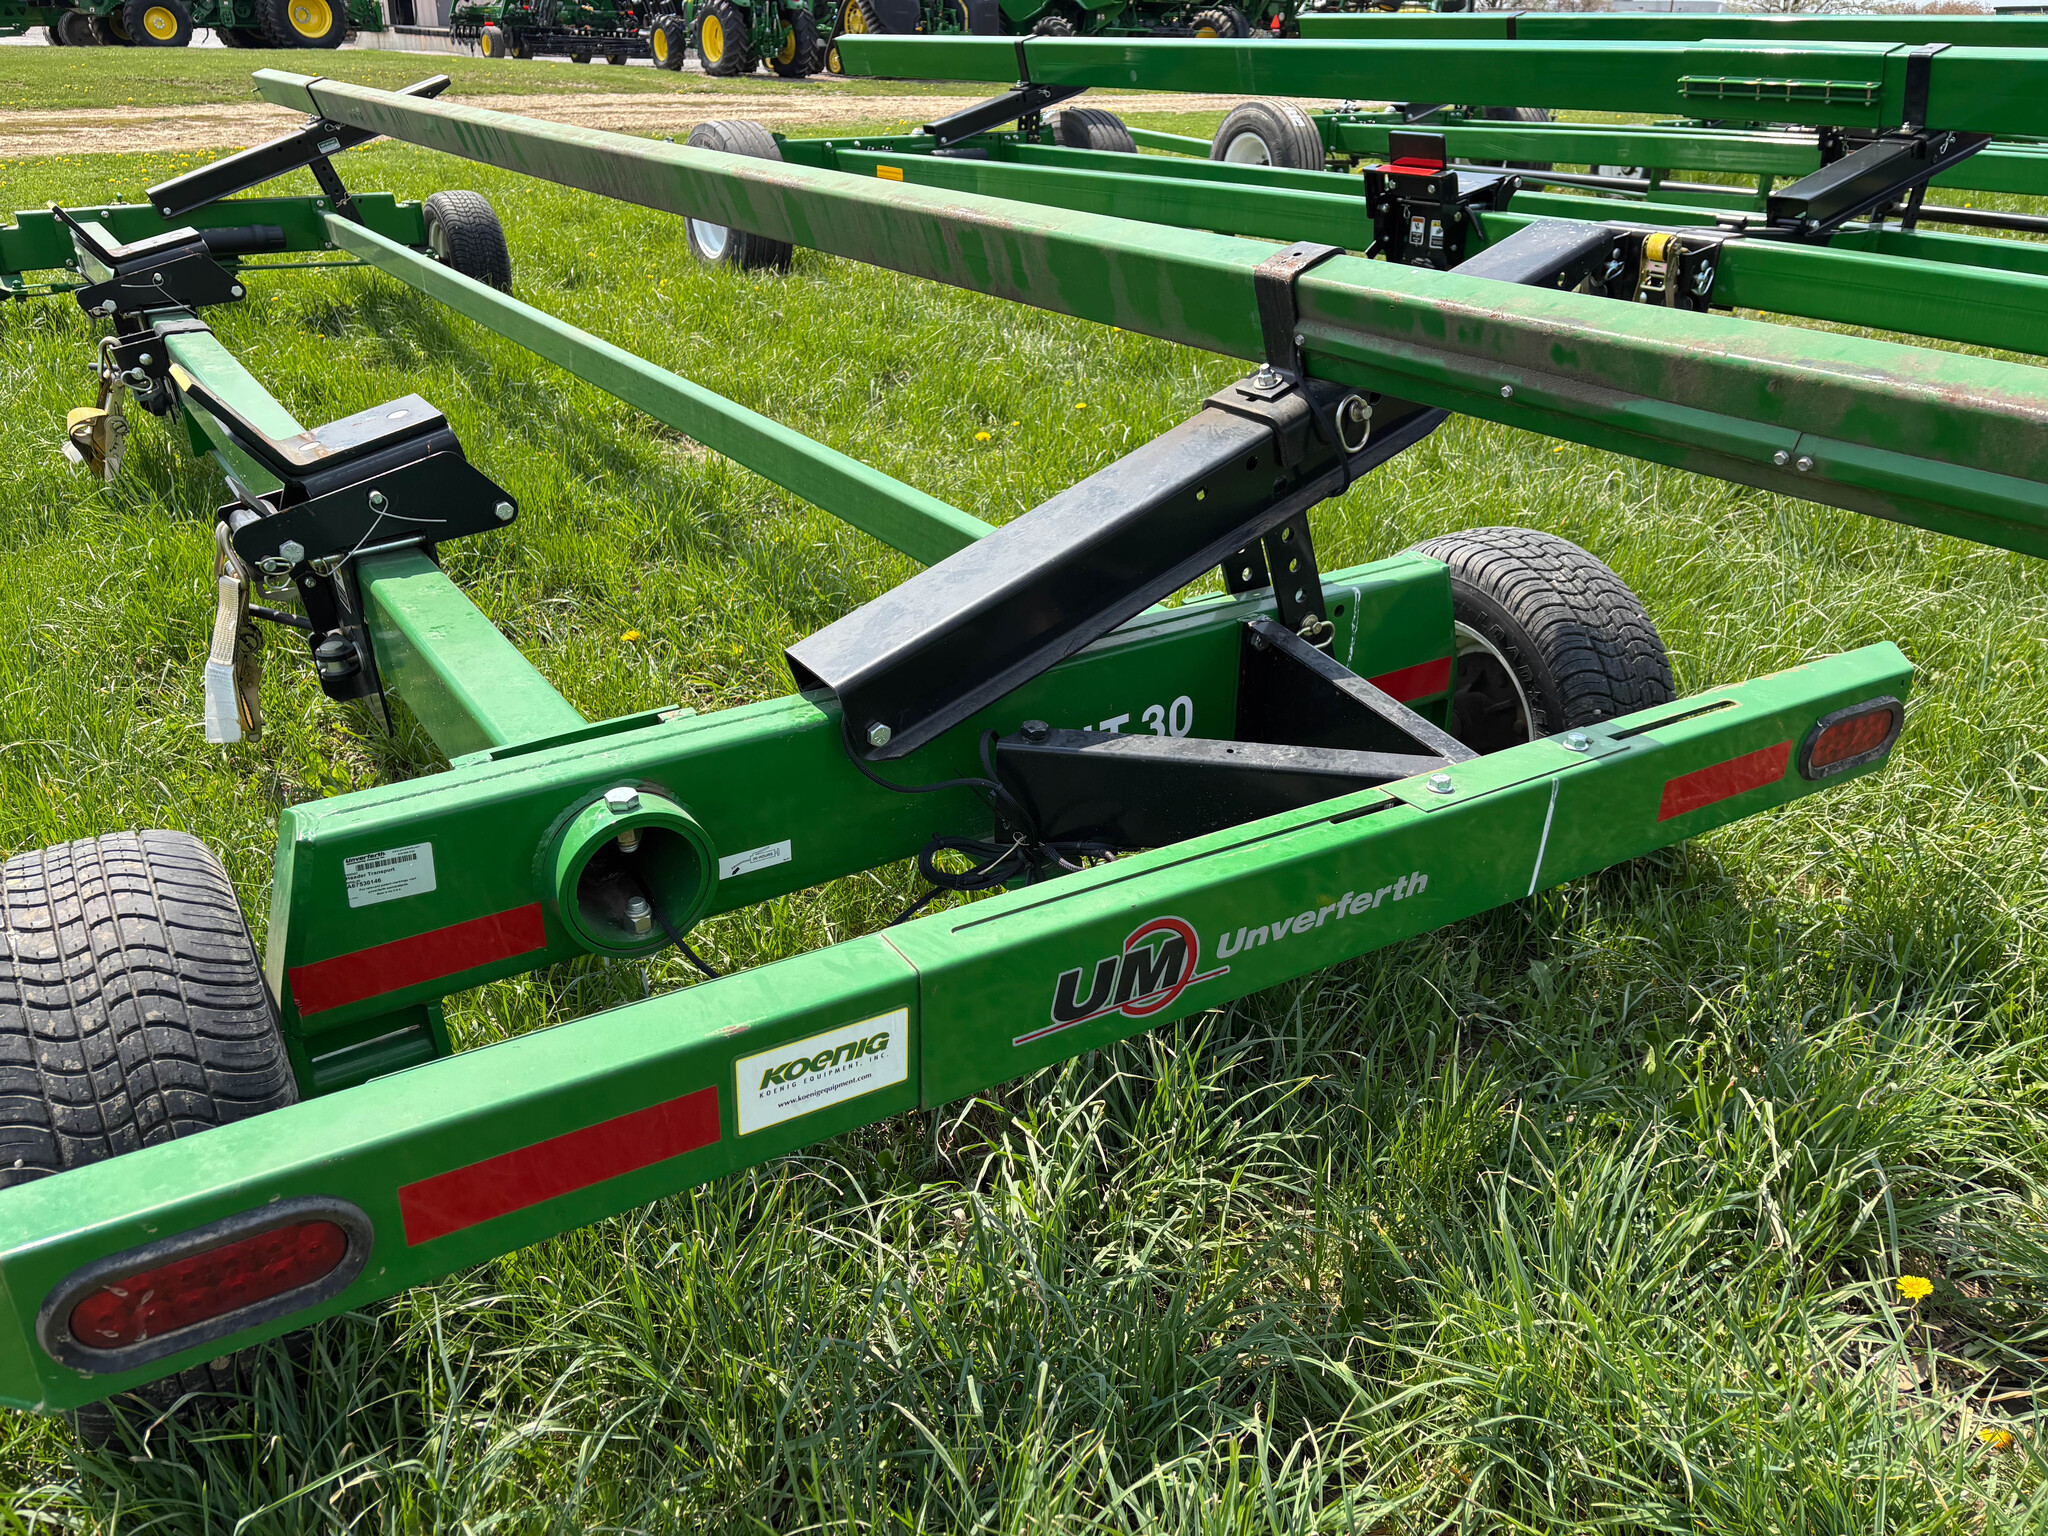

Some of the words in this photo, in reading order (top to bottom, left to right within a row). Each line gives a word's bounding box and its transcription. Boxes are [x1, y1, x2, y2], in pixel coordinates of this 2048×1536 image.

[1141, 695, 1194, 738] 30
[368, 867, 396, 877] Transport
[1051, 935, 1189, 1024] UM
[1215, 870, 1430, 960] Unverferth
[758, 1080, 798, 1099] KOENIG
[802, 1061, 863, 1085] EQUIPMENT,
[868, 1052, 889, 1063] INC.
[777, 1071, 873, 1108] www.koenigequipment.com
